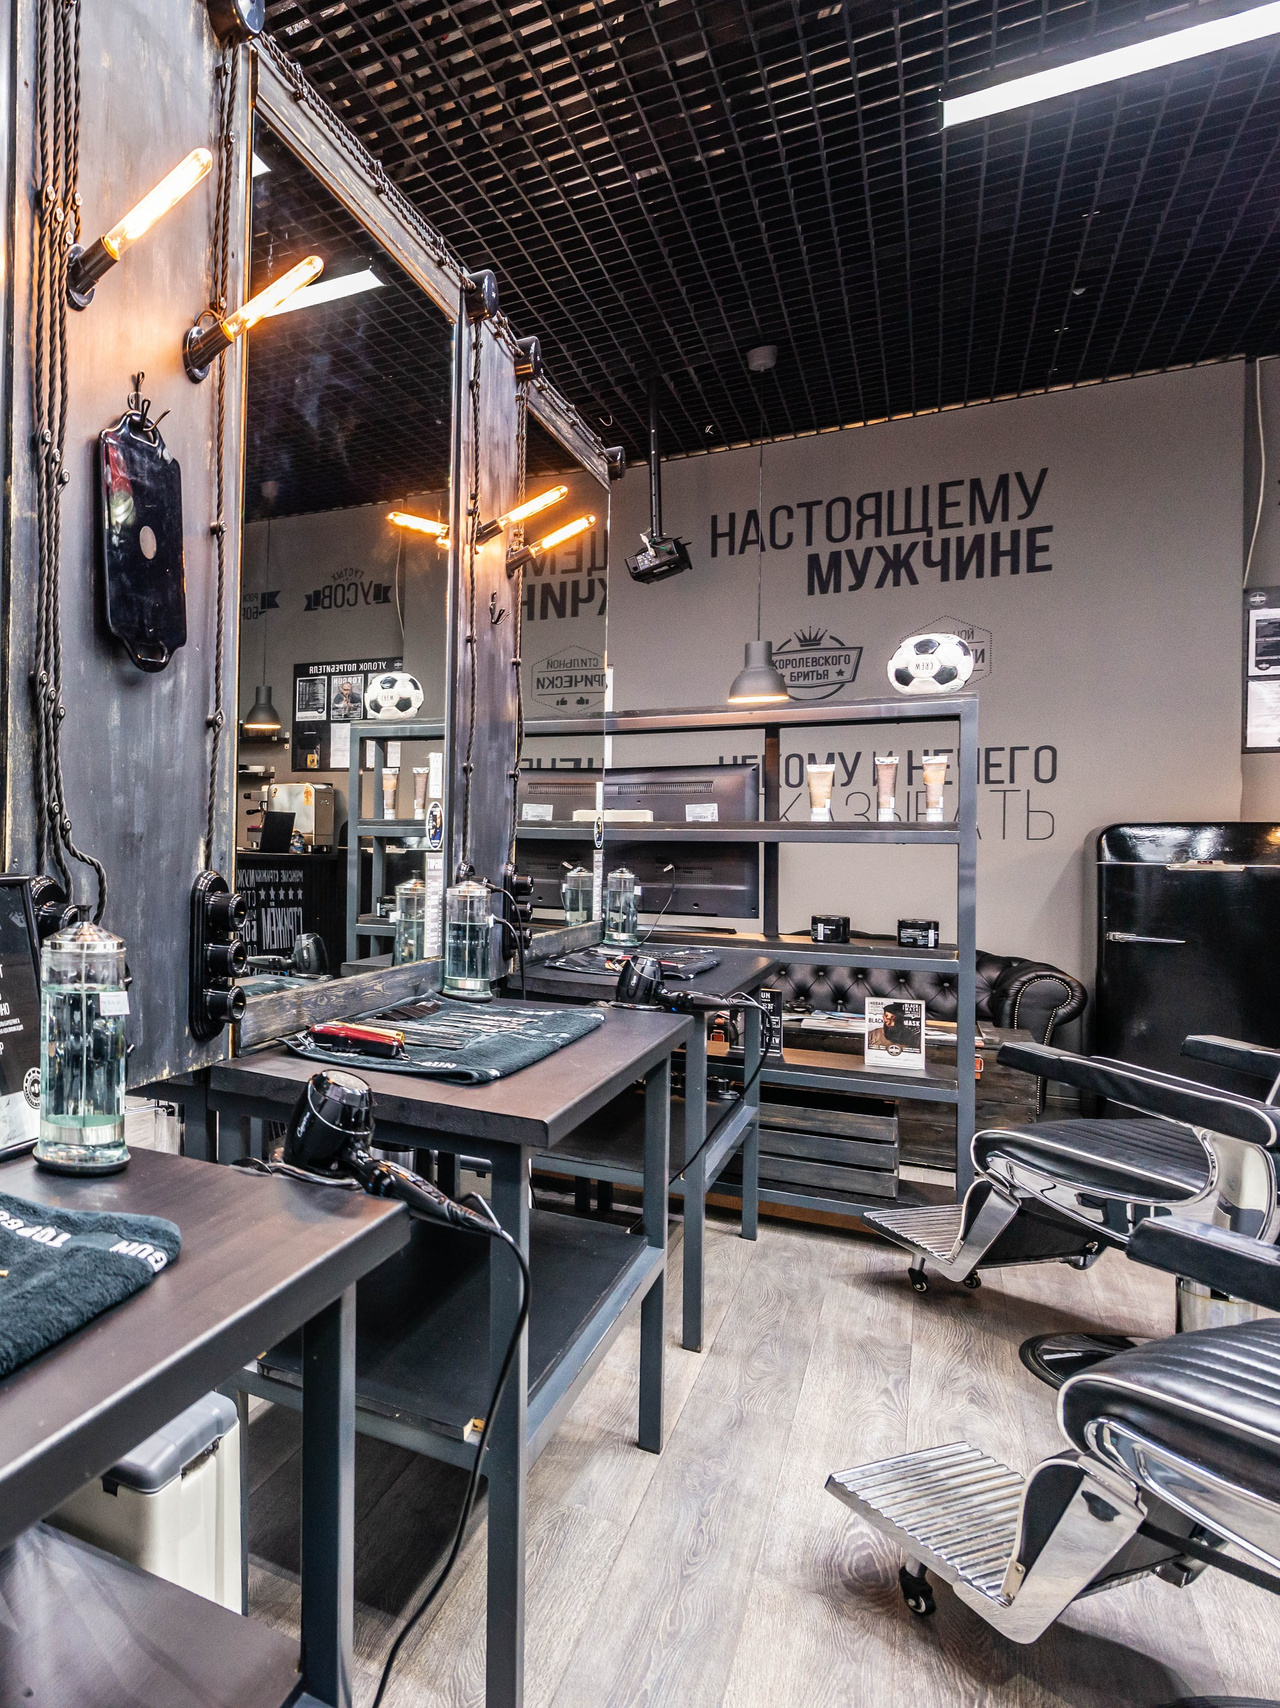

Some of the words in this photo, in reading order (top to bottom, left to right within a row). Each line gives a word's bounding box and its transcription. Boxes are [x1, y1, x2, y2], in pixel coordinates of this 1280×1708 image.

[710, 467, 1049, 558] НАСТОЯЩЕМУ
[807, 525, 1053, 596] МУЖЧИНЕ
[771, 653, 851, 671] КОРОЛЕВСКОГО
[789, 668, 830, 683] БРИТЬЯ
